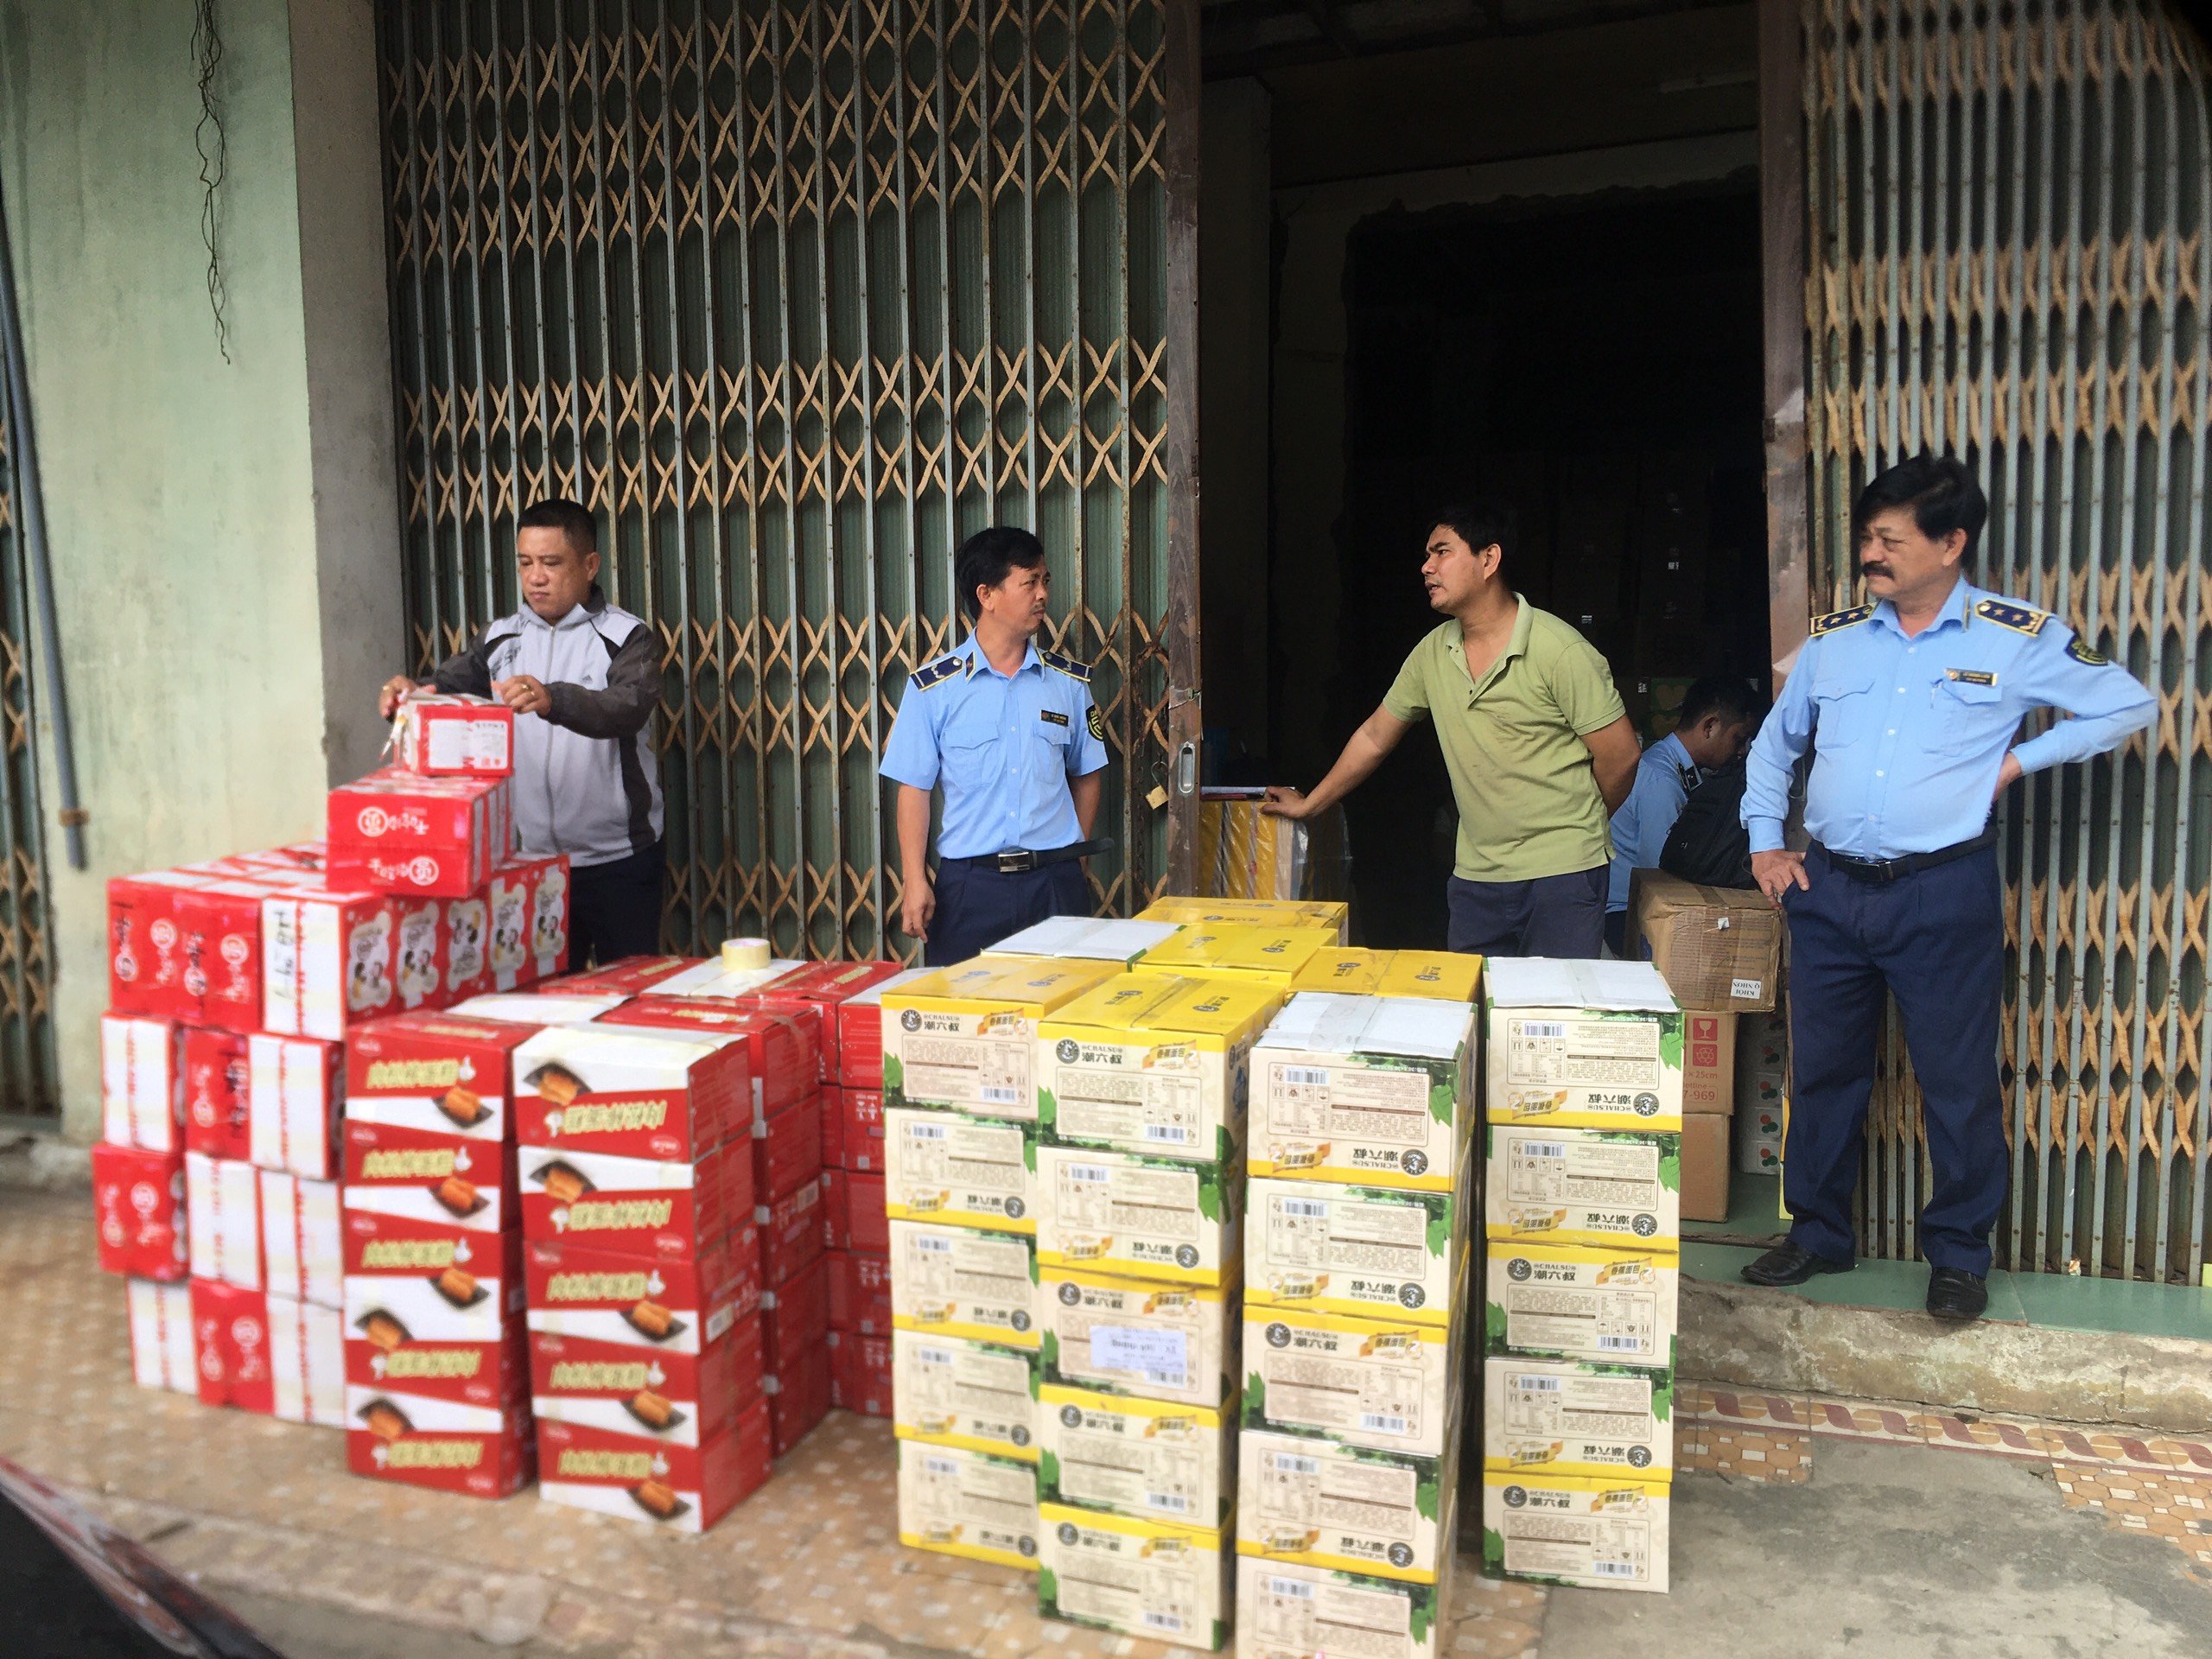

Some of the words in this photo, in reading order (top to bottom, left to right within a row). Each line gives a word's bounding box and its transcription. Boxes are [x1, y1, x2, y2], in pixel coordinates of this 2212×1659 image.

[1081, 1052, 1122, 1065] 潮六叔
[1587, 1093, 1631, 1105] 潮六叔
[1592, 1103, 1625, 1112] CHALSU
[1352, 1148, 1398, 1161] 潮六叔
[1357, 1160, 1392, 1168] CHALSU
[1586, 1212, 1630, 1224] 潮六叔
[1591, 1224, 1624, 1232] CHALSU
[1534, 1270, 1576, 1281] 潮六叔
